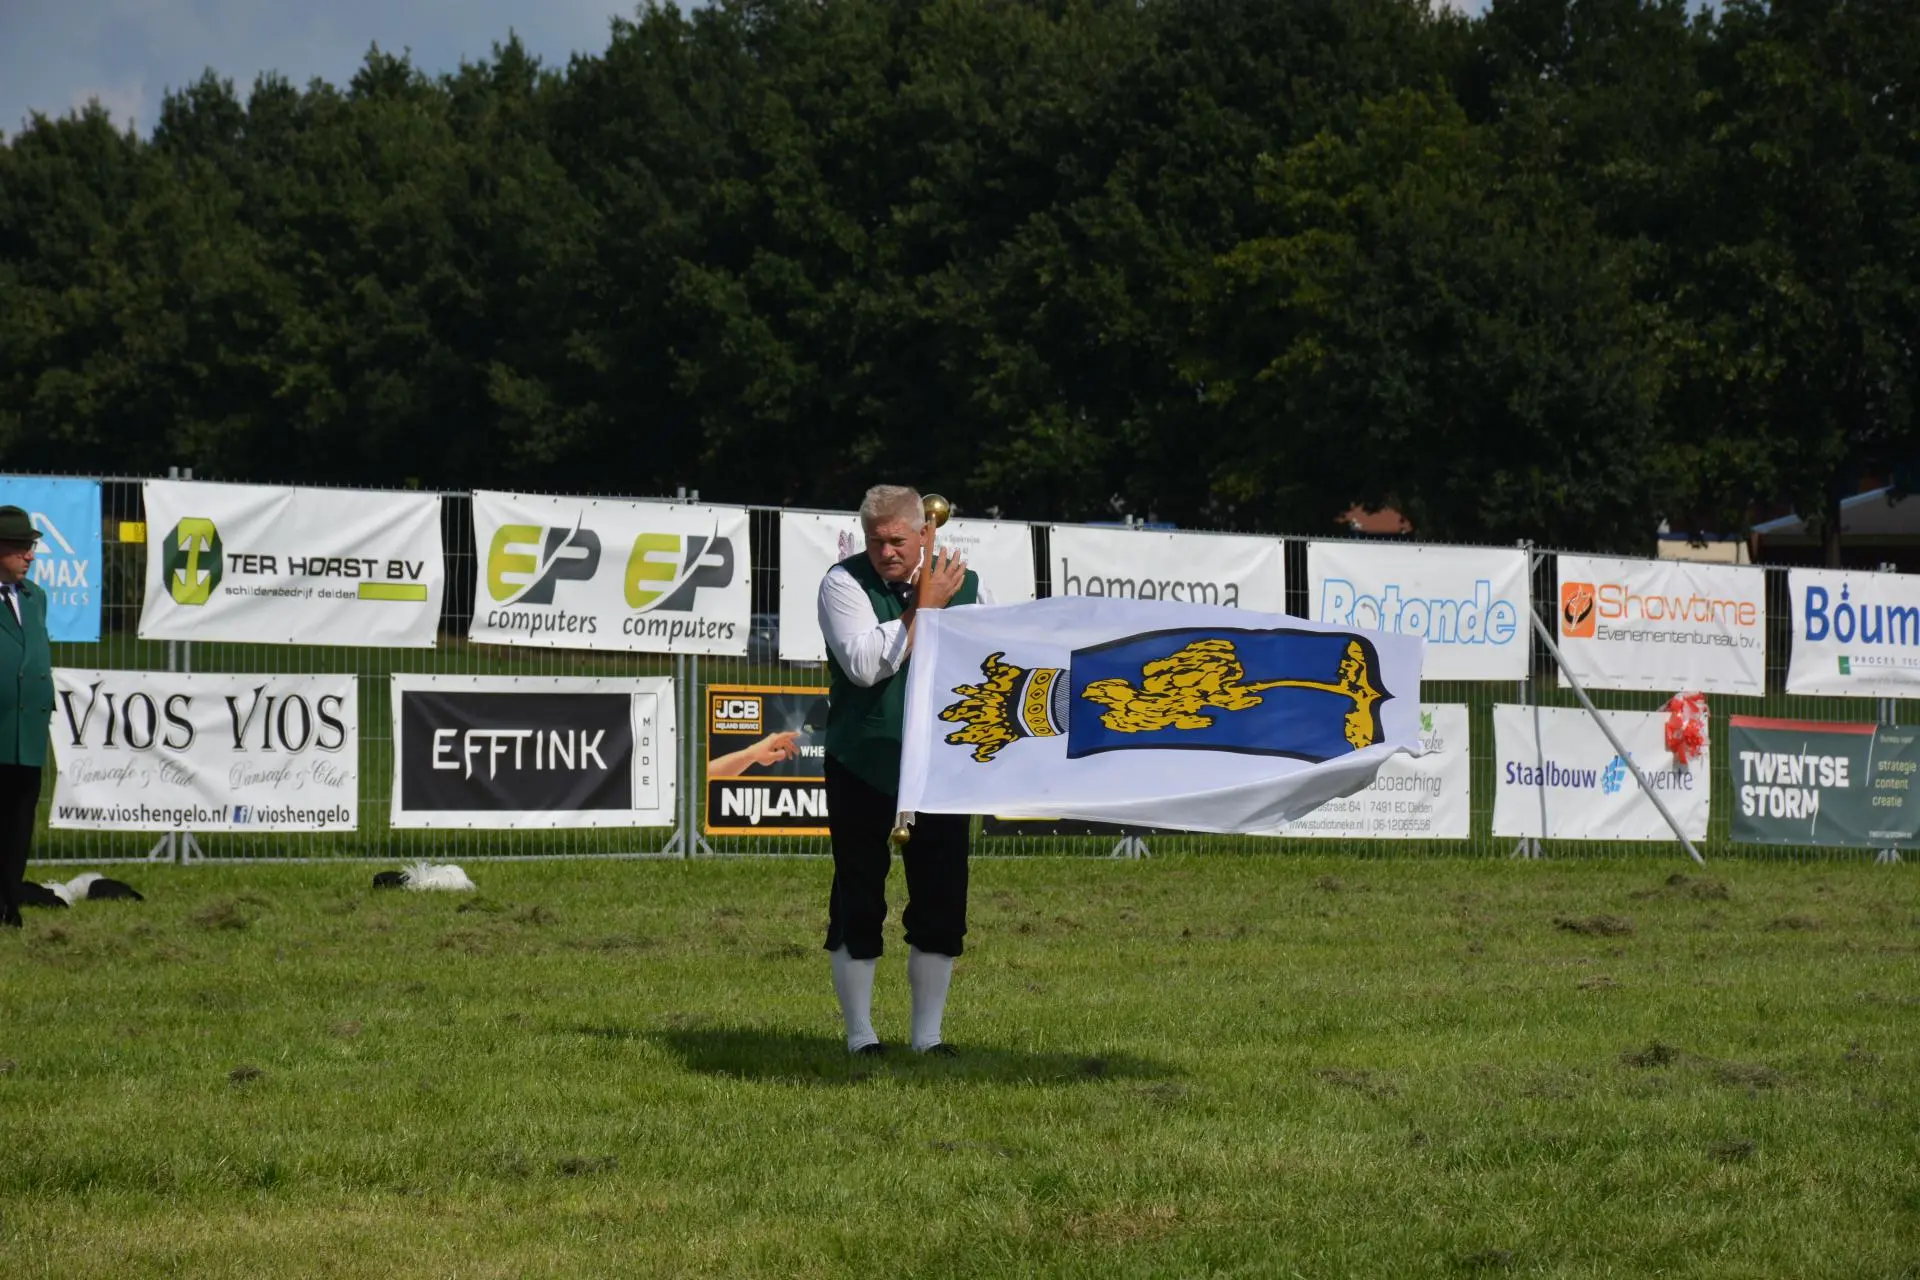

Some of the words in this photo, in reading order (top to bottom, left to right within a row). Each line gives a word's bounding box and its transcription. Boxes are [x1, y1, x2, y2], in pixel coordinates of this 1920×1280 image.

[227, 553, 278, 575] TER
[288, 556, 378, 579] HORST
[386, 560, 424, 580] BV
[487, 508, 602, 607] EP
[623, 516, 735, 615] EP
[225, 585, 313, 600] schildersbedrijf
[1598, 583, 1757, 626] Showtime
[487, 610, 597, 638] computers
[1321, 578, 1517, 645] Rotonde
[622, 616, 736, 645] computers
[1597, 624, 1738, 648] Evenementenbureau
[59, 679, 197, 753] VIOS
[225, 683, 348, 754] VIOS
[715, 700, 759, 719] JCB
[432, 728, 608, 781] EFFTINK
[1878, 761, 1917, 775] strategie
[1506, 761, 1597, 788] Staalbouw
[1740, 750, 1850, 788] TWENTSE
[1875, 778, 1909, 790] content
[58, 804, 228, 827] www.vioshengelo.nl
[257, 806, 350, 828] vioshengelo
[1740, 784, 1819, 820] STORM
